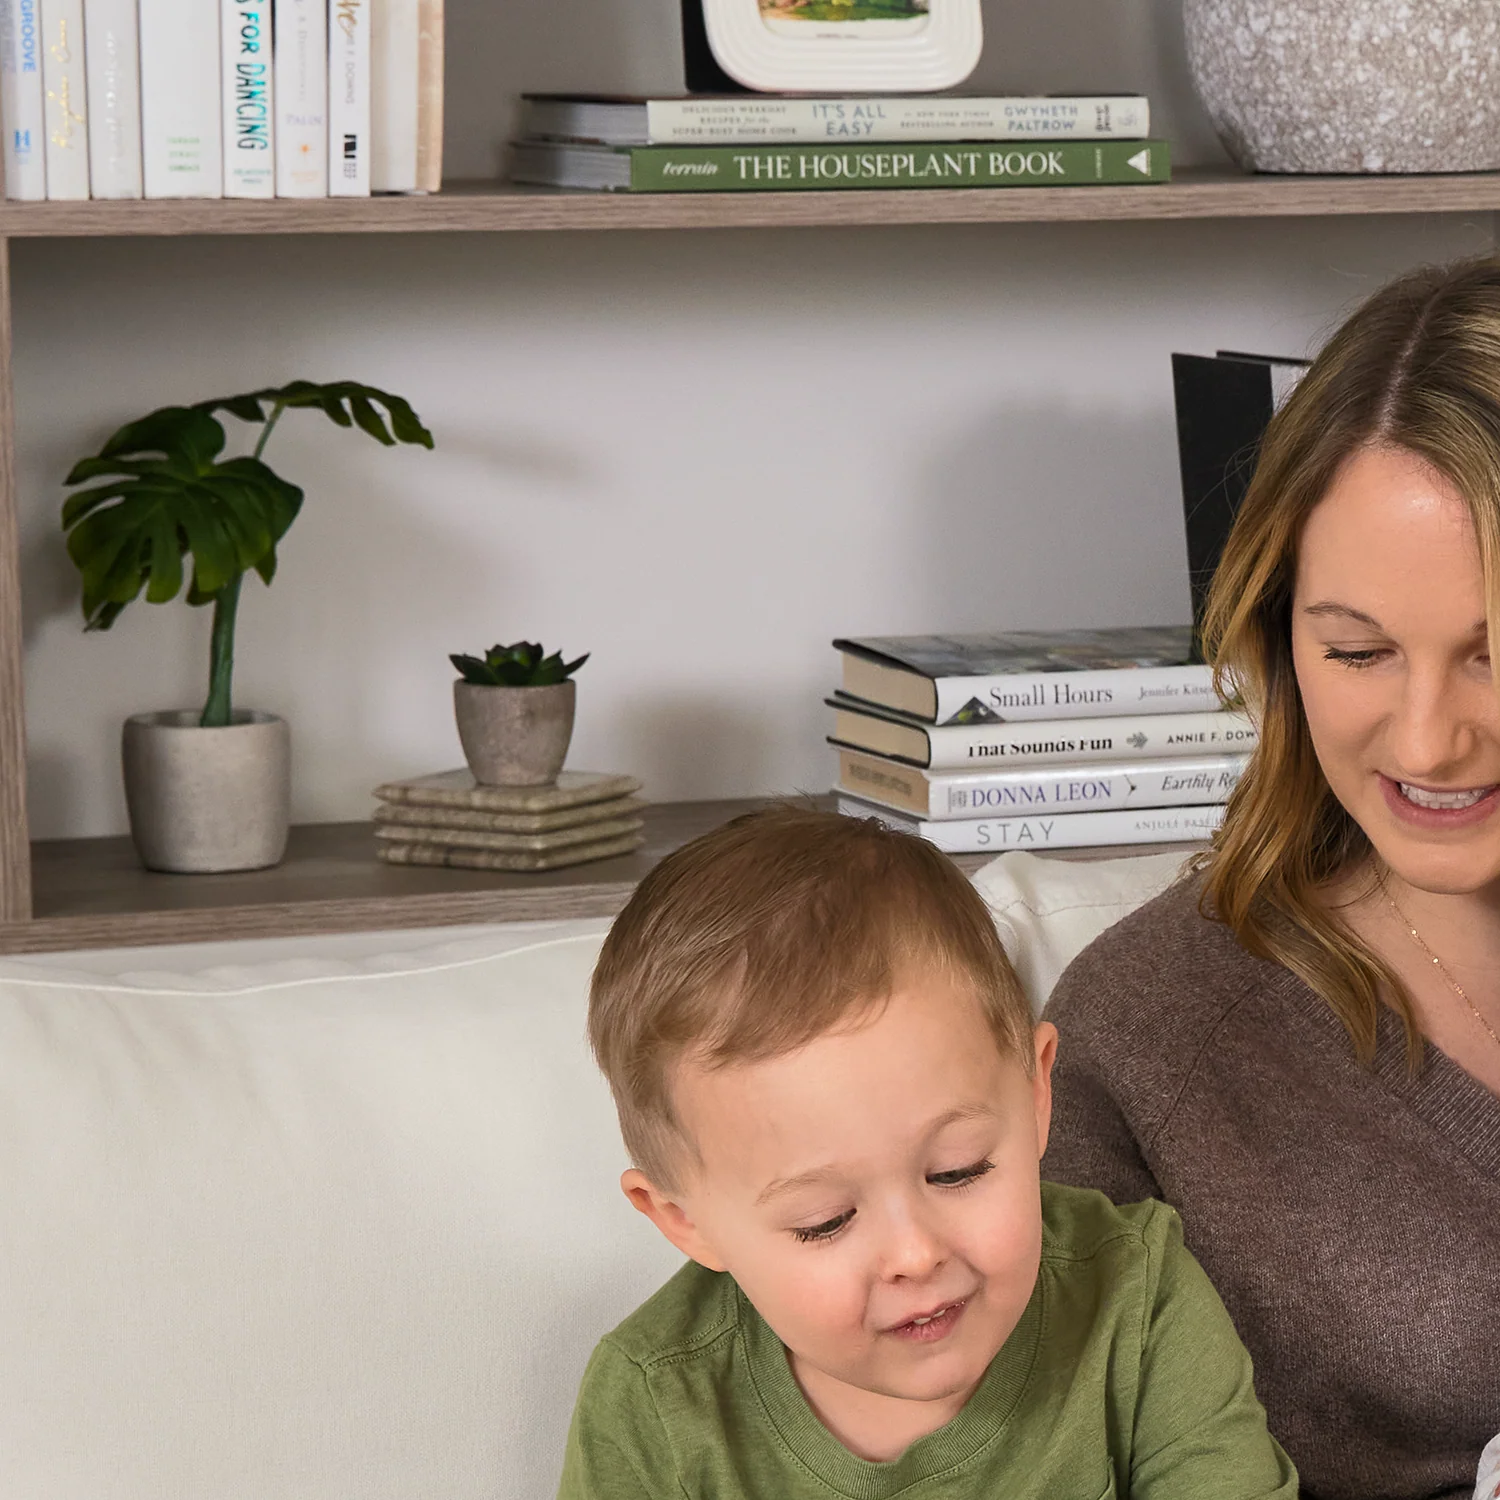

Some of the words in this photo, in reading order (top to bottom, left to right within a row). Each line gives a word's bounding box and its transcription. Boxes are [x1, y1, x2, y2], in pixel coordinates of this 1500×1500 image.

[239, 11, 260, 54] FOR
[235, 63, 268, 150] DANCING
[811, 104, 846, 119] IT'S
[853, 103, 887, 119] ALL
[1004, 105, 1079, 118] GWYNETH
[826, 121, 874, 136] EASY
[1008, 119, 1076, 133] PALTROW
[662, 161, 719, 177] terrain
[733, 154, 792, 180] THE
[799, 151, 981, 179] HOUSEPLANT
[989, 150, 1065, 176] BOOK
[989, 683, 1046, 708] Small
[1053, 683, 1114, 705] Hours
[1138, 685, 1180, 701] Jennifer
[1167, 732, 1207, 745] ANNIE
[971, 784, 1048, 808] DONNA
[1054, 779, 1113, 803] LEON
[1161, 771, 1215, 793] Earthly
[976, 820, 1055, 846] STAY
